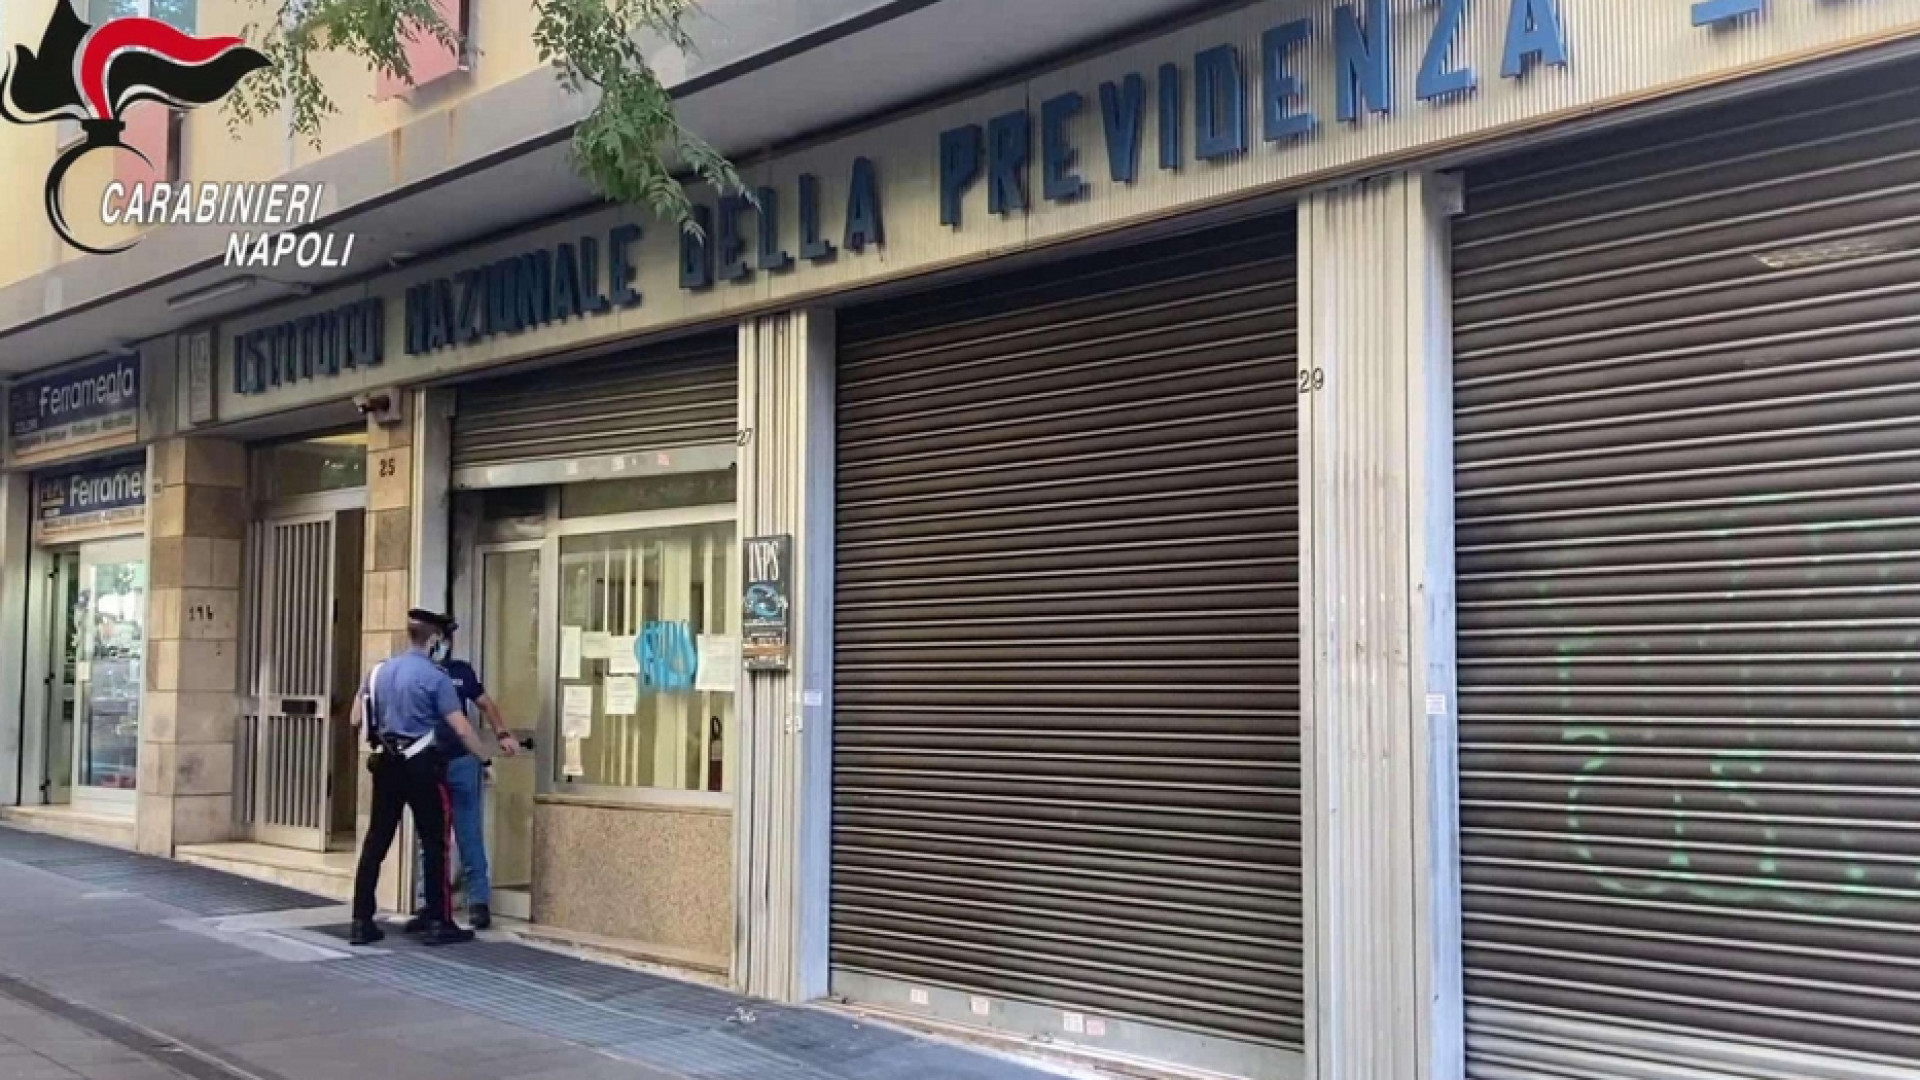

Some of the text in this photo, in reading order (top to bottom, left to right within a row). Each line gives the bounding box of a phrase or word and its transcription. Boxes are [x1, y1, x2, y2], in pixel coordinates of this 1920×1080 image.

[233, 0, 1567, 395] ISTITUTO NAZIONALE DELLA PREVIDENZA
[1299, 368, 1324, 392] 29
[738, 428, 753, 446] 27
[379, 458, 395, 477] 25
[70, 471, 147, 507] Ferrame
[748, 541, 779, 582] INPS
